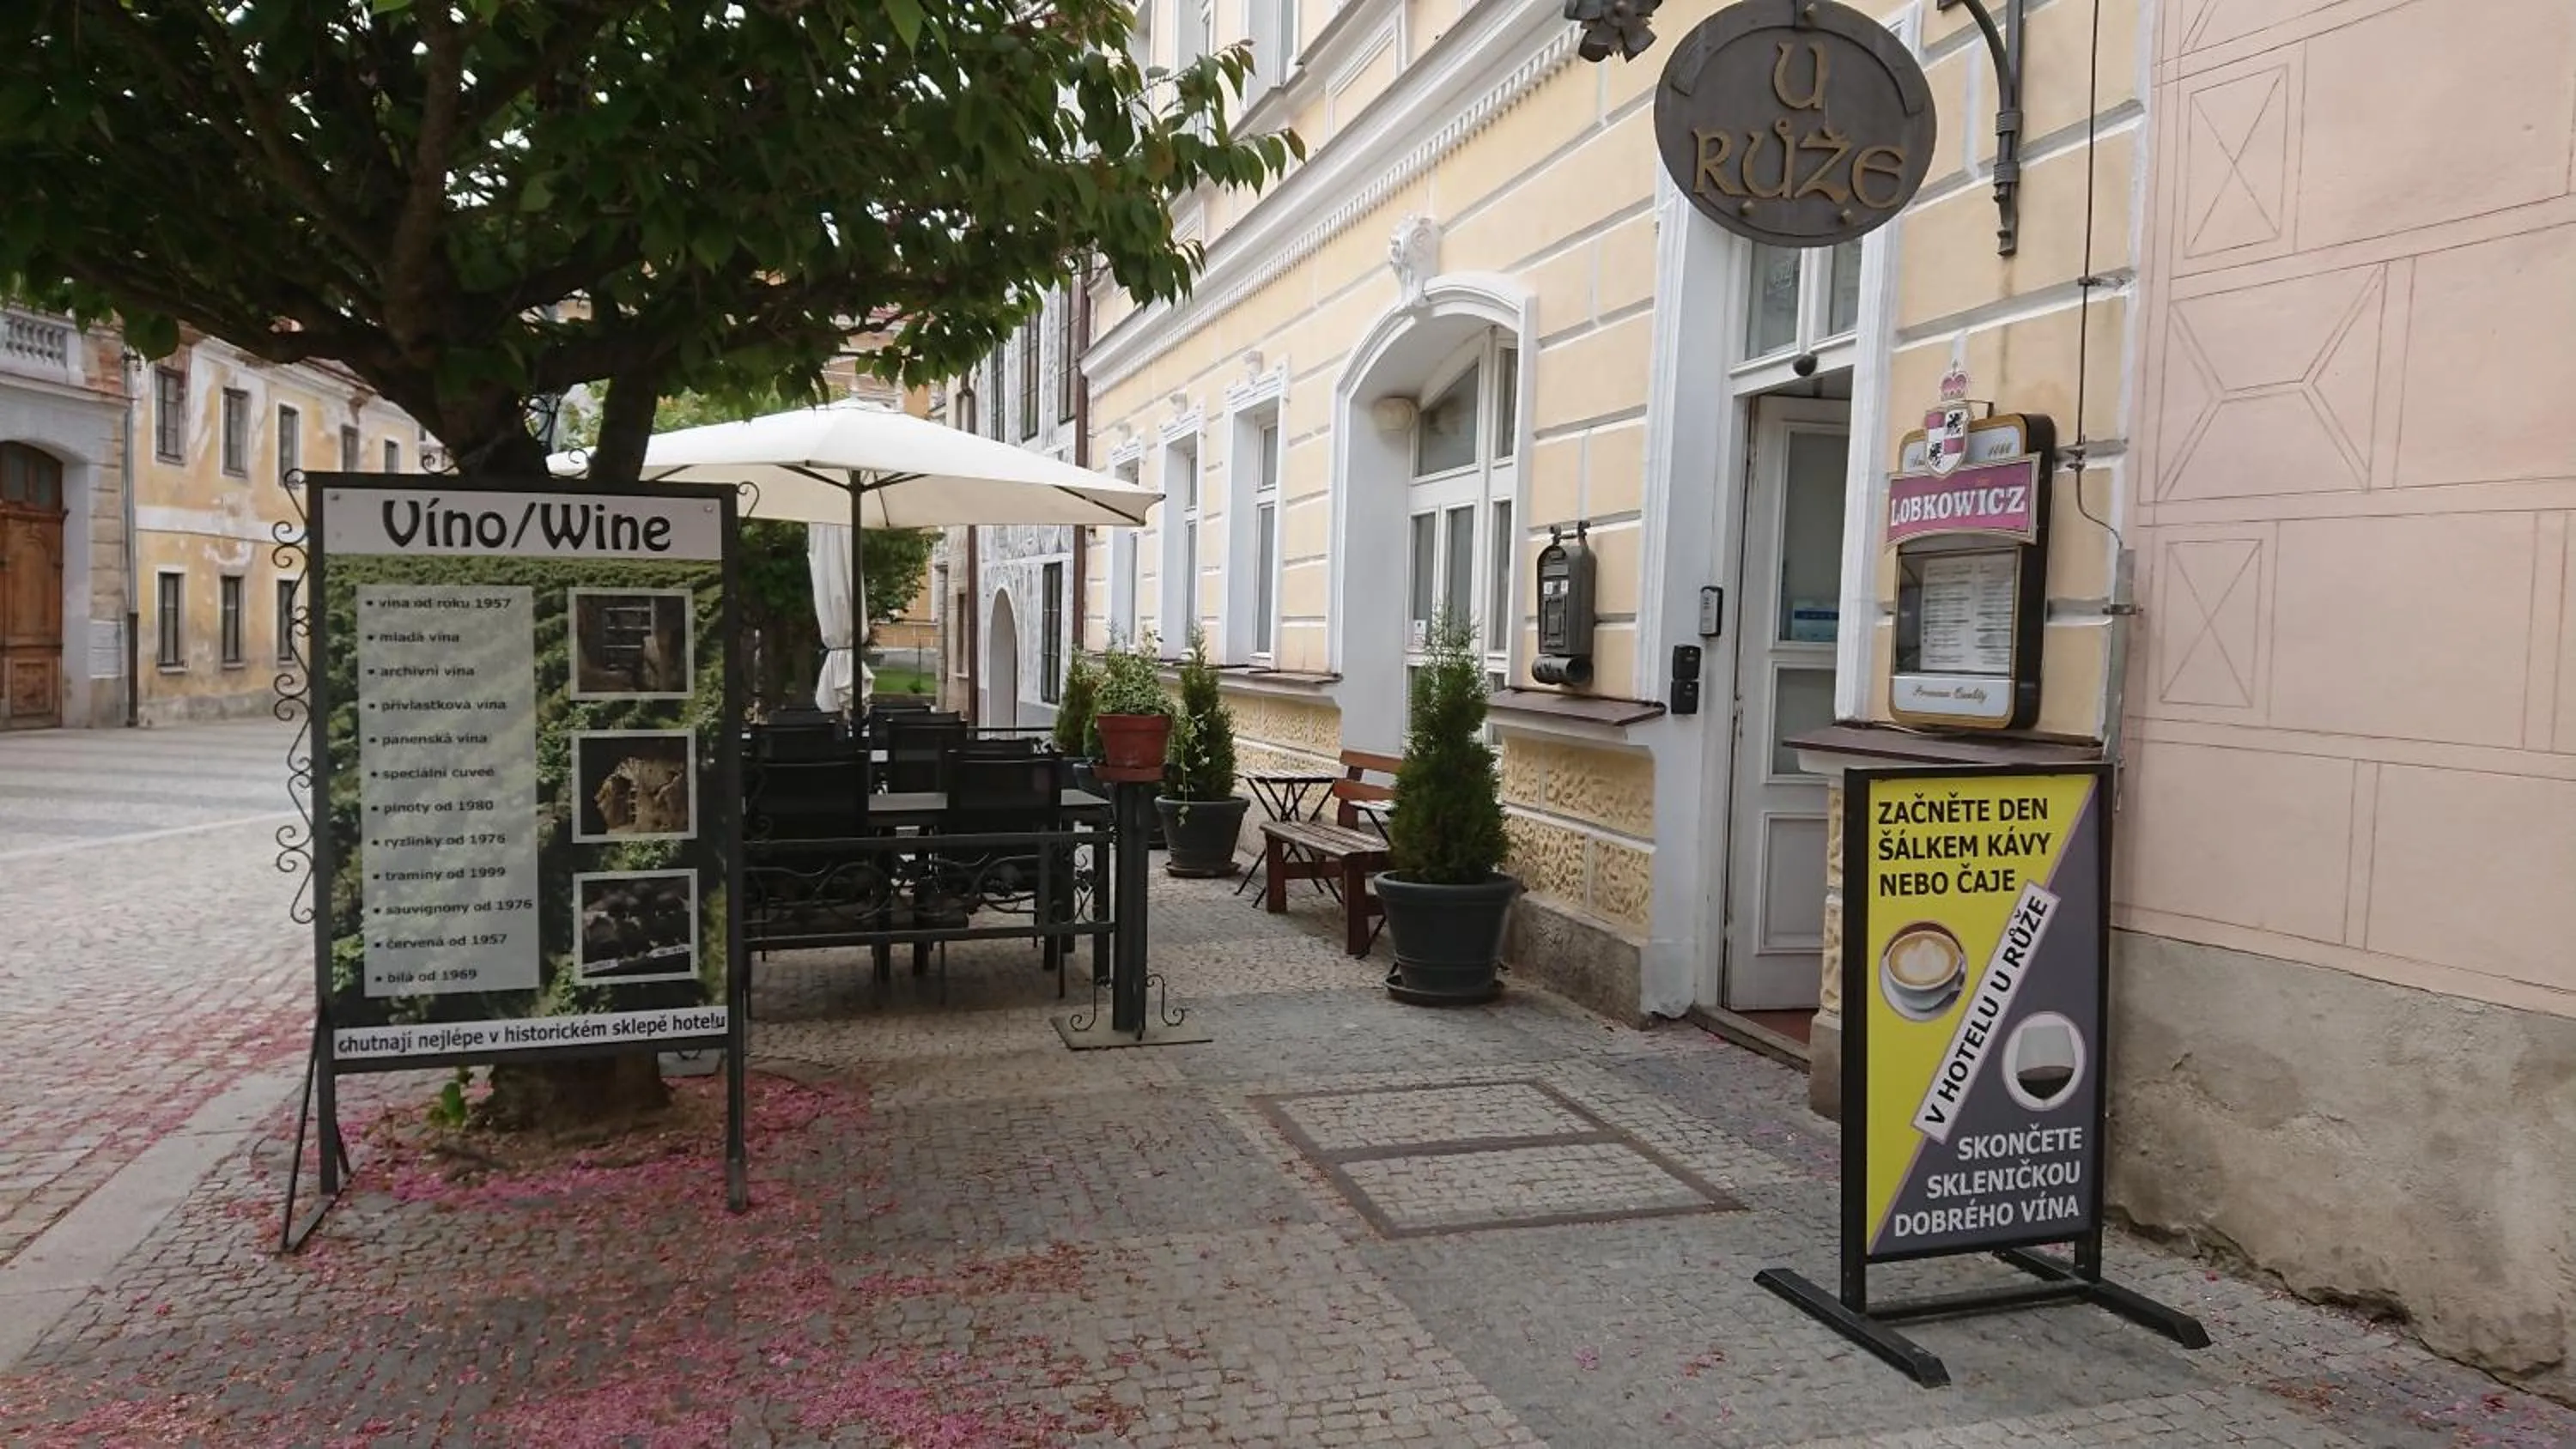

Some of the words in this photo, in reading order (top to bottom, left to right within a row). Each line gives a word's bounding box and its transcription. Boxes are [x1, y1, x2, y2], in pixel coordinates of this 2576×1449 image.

[1773, 41, 1829, 110] U
[1891, 486, 2026, 526] LOBKOWICZ
[382, 498, 671, 551] Víno/Wine
[413, 597, 432, 609] od
[437, 597, 471, 609] roku
[475, 597, 511, 609] 1957
[384, 800, 429, 815] pinoty
[434, 800, 453, 811] od
[459, 799, 494, 811] 1980
[1877, 791, 1990, 825] ZAČNĚTE
[1999, 797, 2048, 821] DEN
[385, 834, 441, 850] ryzlinky
[446, 834, 465, 846] od
[1878, 828, 1978, 860] ŠÁLKEM
[1988, 826, 2051, 856] KÁVY
[447, 867, 465, 880] od
[471, 865, 506, 878] 1999
[1880, 871, 1948, 896] NEBO
[1957, 863, 2015, 894] ČAJE
[386, 901, 471, 917] sauvignony
[474, 900, 492, 912] od
[449, 935, 466, 947] od
[473, 933, 507, 945] 1957
[418, 970, 435, 981] od
[442, 968, 477, 980] 1969
[1925, 1103, 1946, 1125] V
[1937, 995, 2000, 1102] HOTELU
[1990, 969, 2013, 993] U
[2002, 895, 2048, 968] RŮŽE
[489, 1031, 503, 1044] v
[505, 1019, 607, 1042] historickém
[611, 1014, 667, 1037] sklepě
[672, 1012, 726, 1031] hotelu
[1958, 1123, 2082, 1161] SKONČETE
[1926, 1159, 2081, 1199] SKLENIČKOU
[1894, 1198, 2014, 1237] DOBRÉHO
[2020, 1191, 2080, 1222] VÍNA
